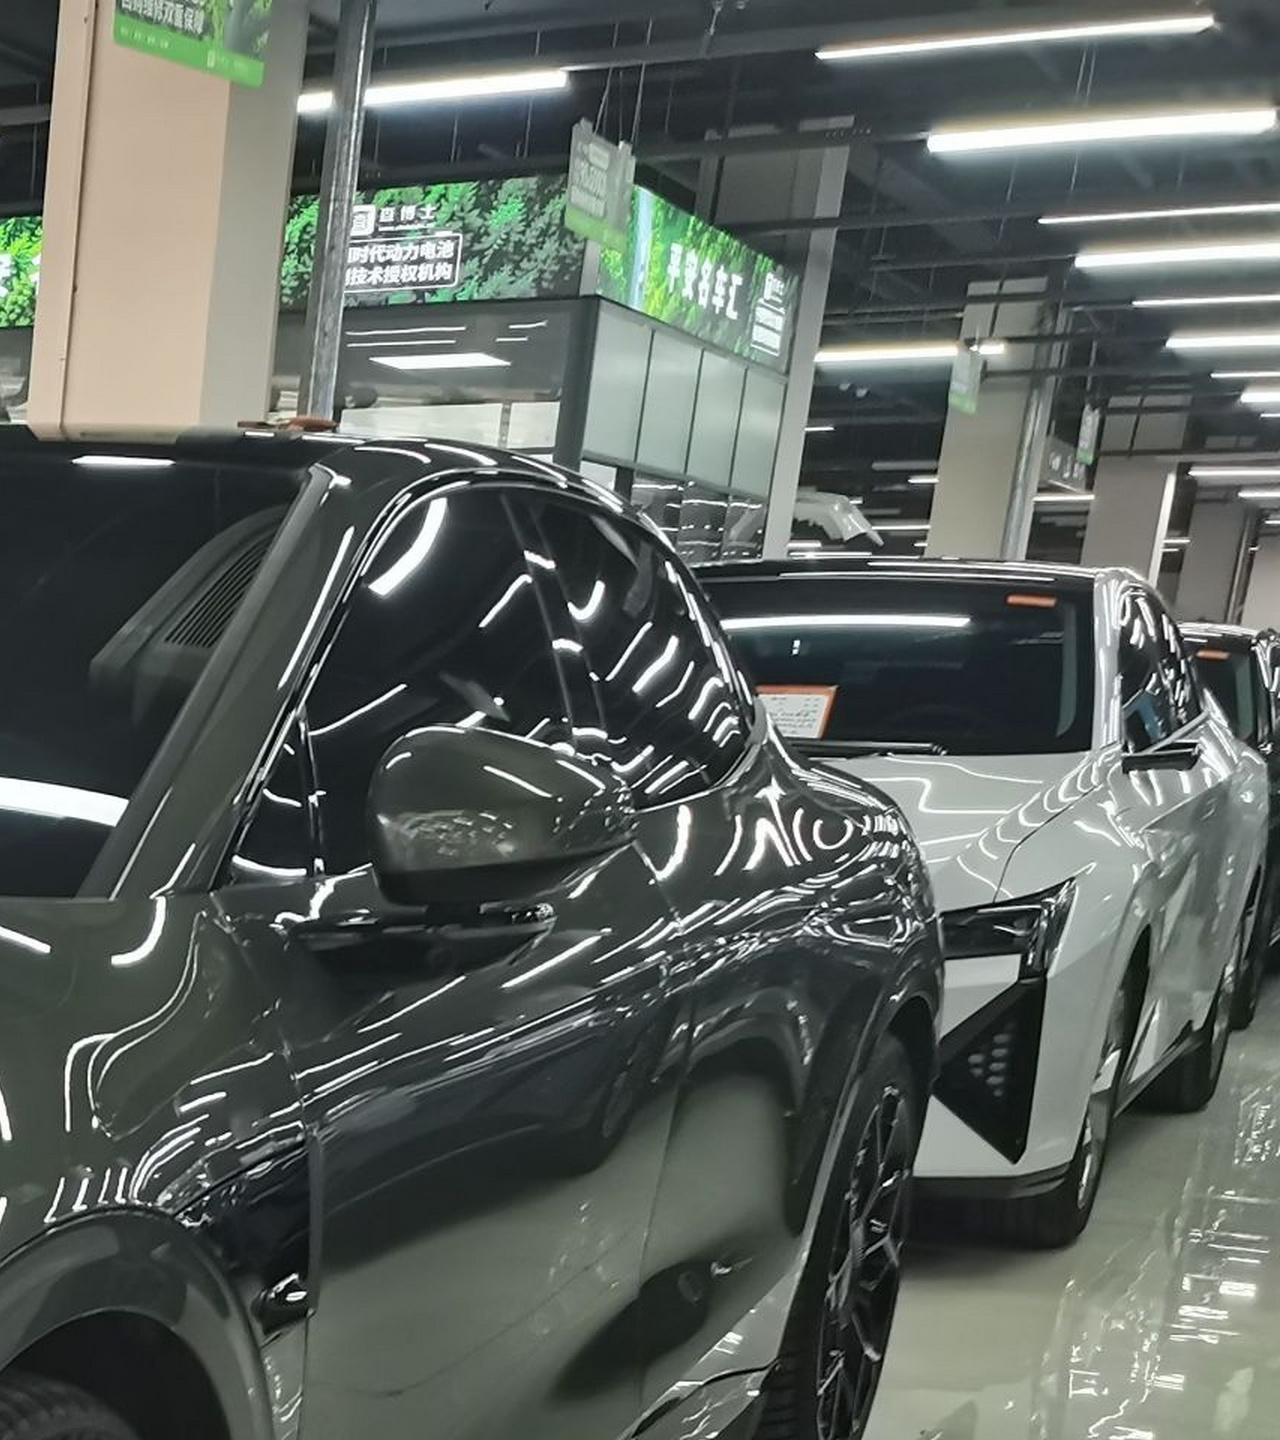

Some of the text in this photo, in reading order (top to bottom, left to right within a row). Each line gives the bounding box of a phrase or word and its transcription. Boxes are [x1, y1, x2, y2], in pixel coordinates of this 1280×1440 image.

[348, 240, 455, 264] 时代动力电池
